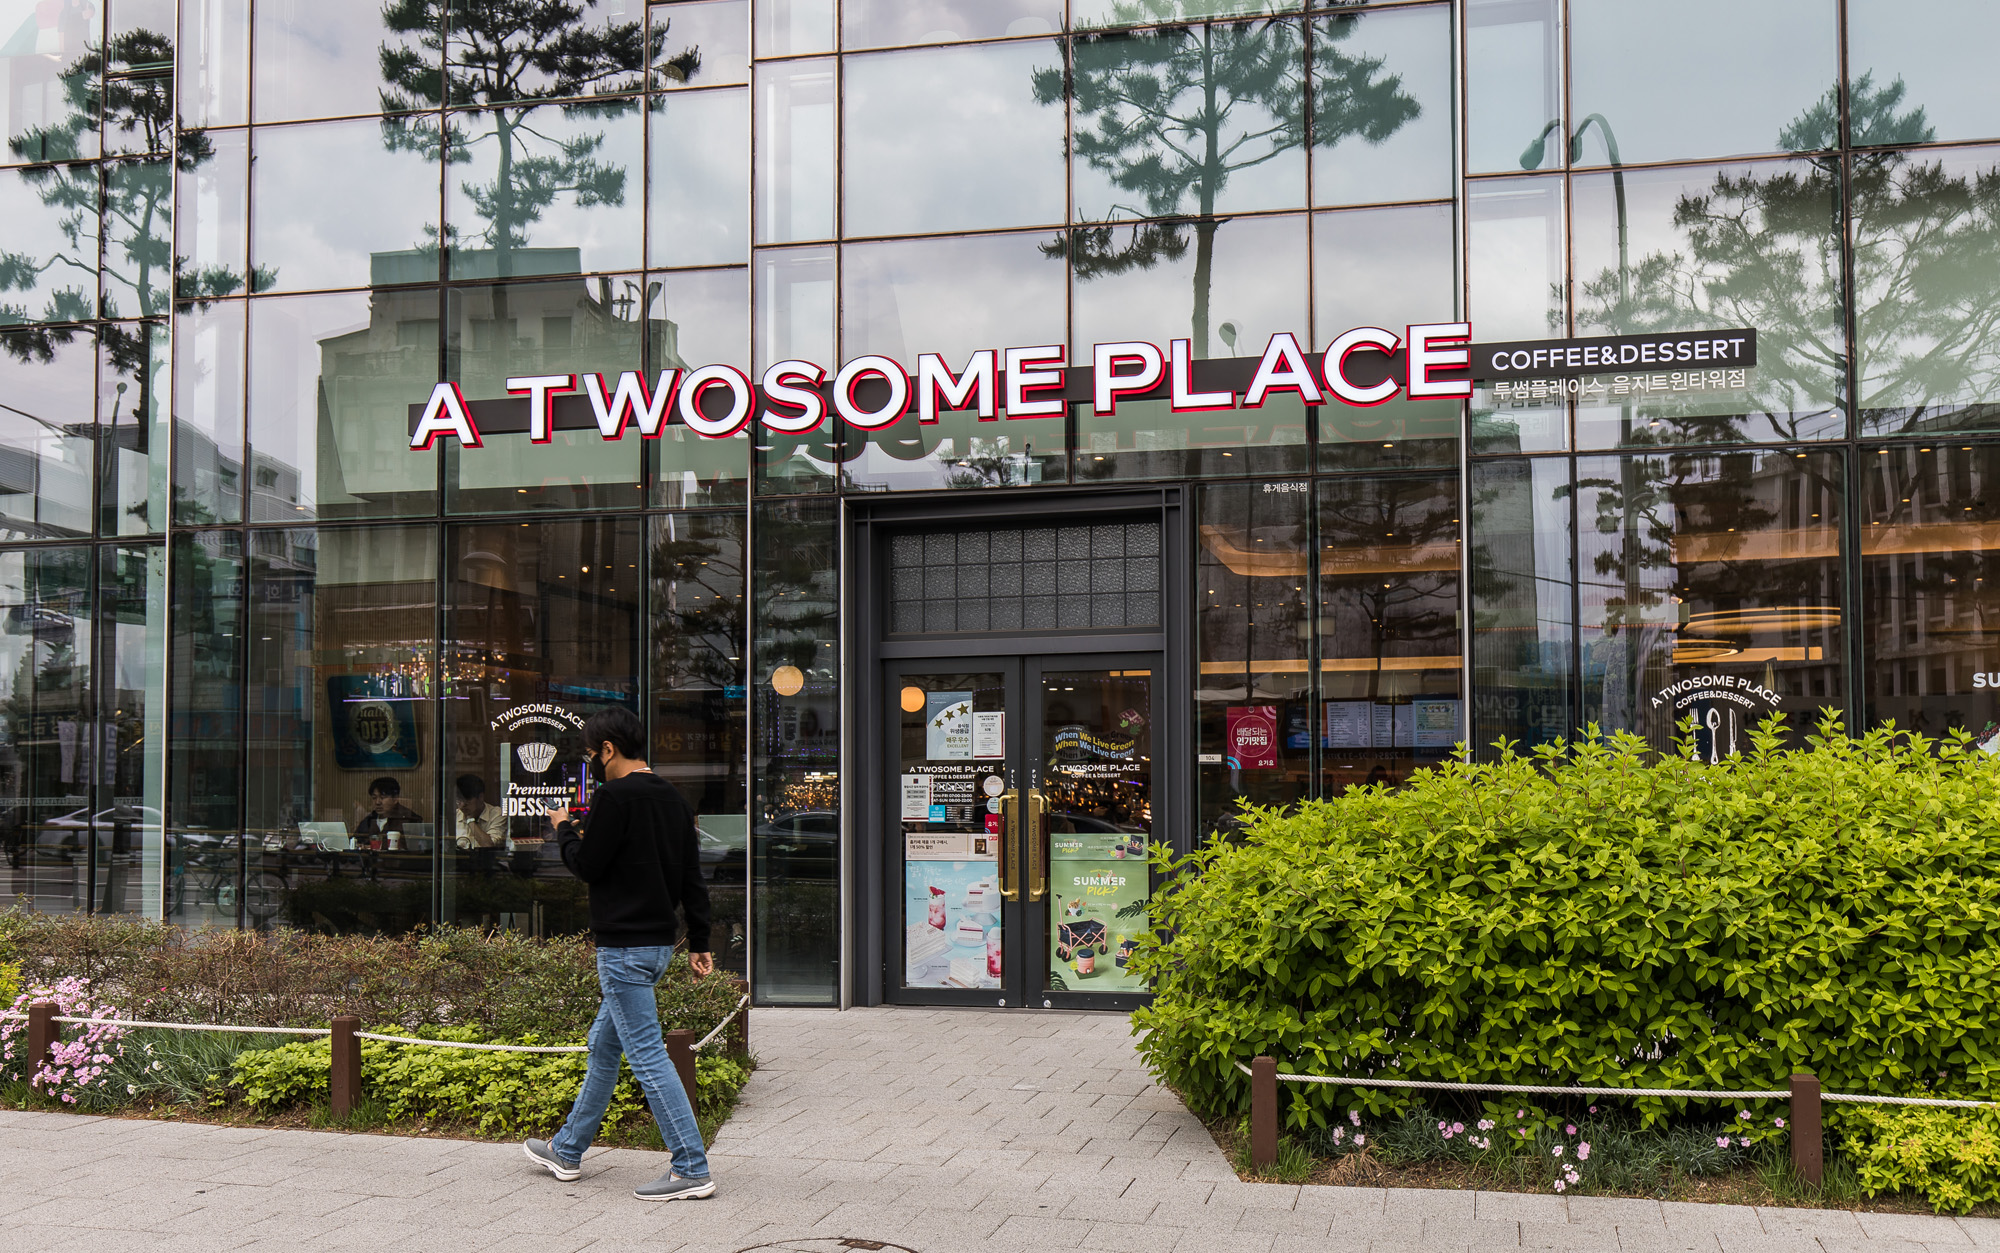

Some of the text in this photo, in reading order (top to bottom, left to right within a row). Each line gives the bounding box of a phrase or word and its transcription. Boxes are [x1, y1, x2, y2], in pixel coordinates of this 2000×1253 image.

[1491, 337, 1746, 371] COFFEE&DESSERT
[410, 321, 1474, 450] A TWOSOME PLACE
[1493, 368, 1747, 400] 투썸플레이스 을지트윈타워점
[1263, 482, 1308, 493] 휴게음식점
[1650, 675, 1783, 709] A TWOSOME PLACE
[1675, 690, 1756, 709] COFFEE&DESSERT
[490, 703, 586, 731] A TWOSOME PLACE
[508, 716, 568, 732] COFFEE&DESSERT
[1236, 727, 1268, 736] 배달되는
[1055, 731, 1135, 751] When We Live Green
[1236, 736, 1268, 746] 인기맛집
[1055, 740, 1135, 759] When We Live Green
[917, 765, 962, 773] TWOSOME
[1060, 764, 1107, 772] TWOSOME
[1109, 763, 1141, 771] PLACE
[506, 782, 568, 795] Premium
[1073, 876, 1126, 886] SUMMER
[1086, 886, 1118, 896] PICK?
